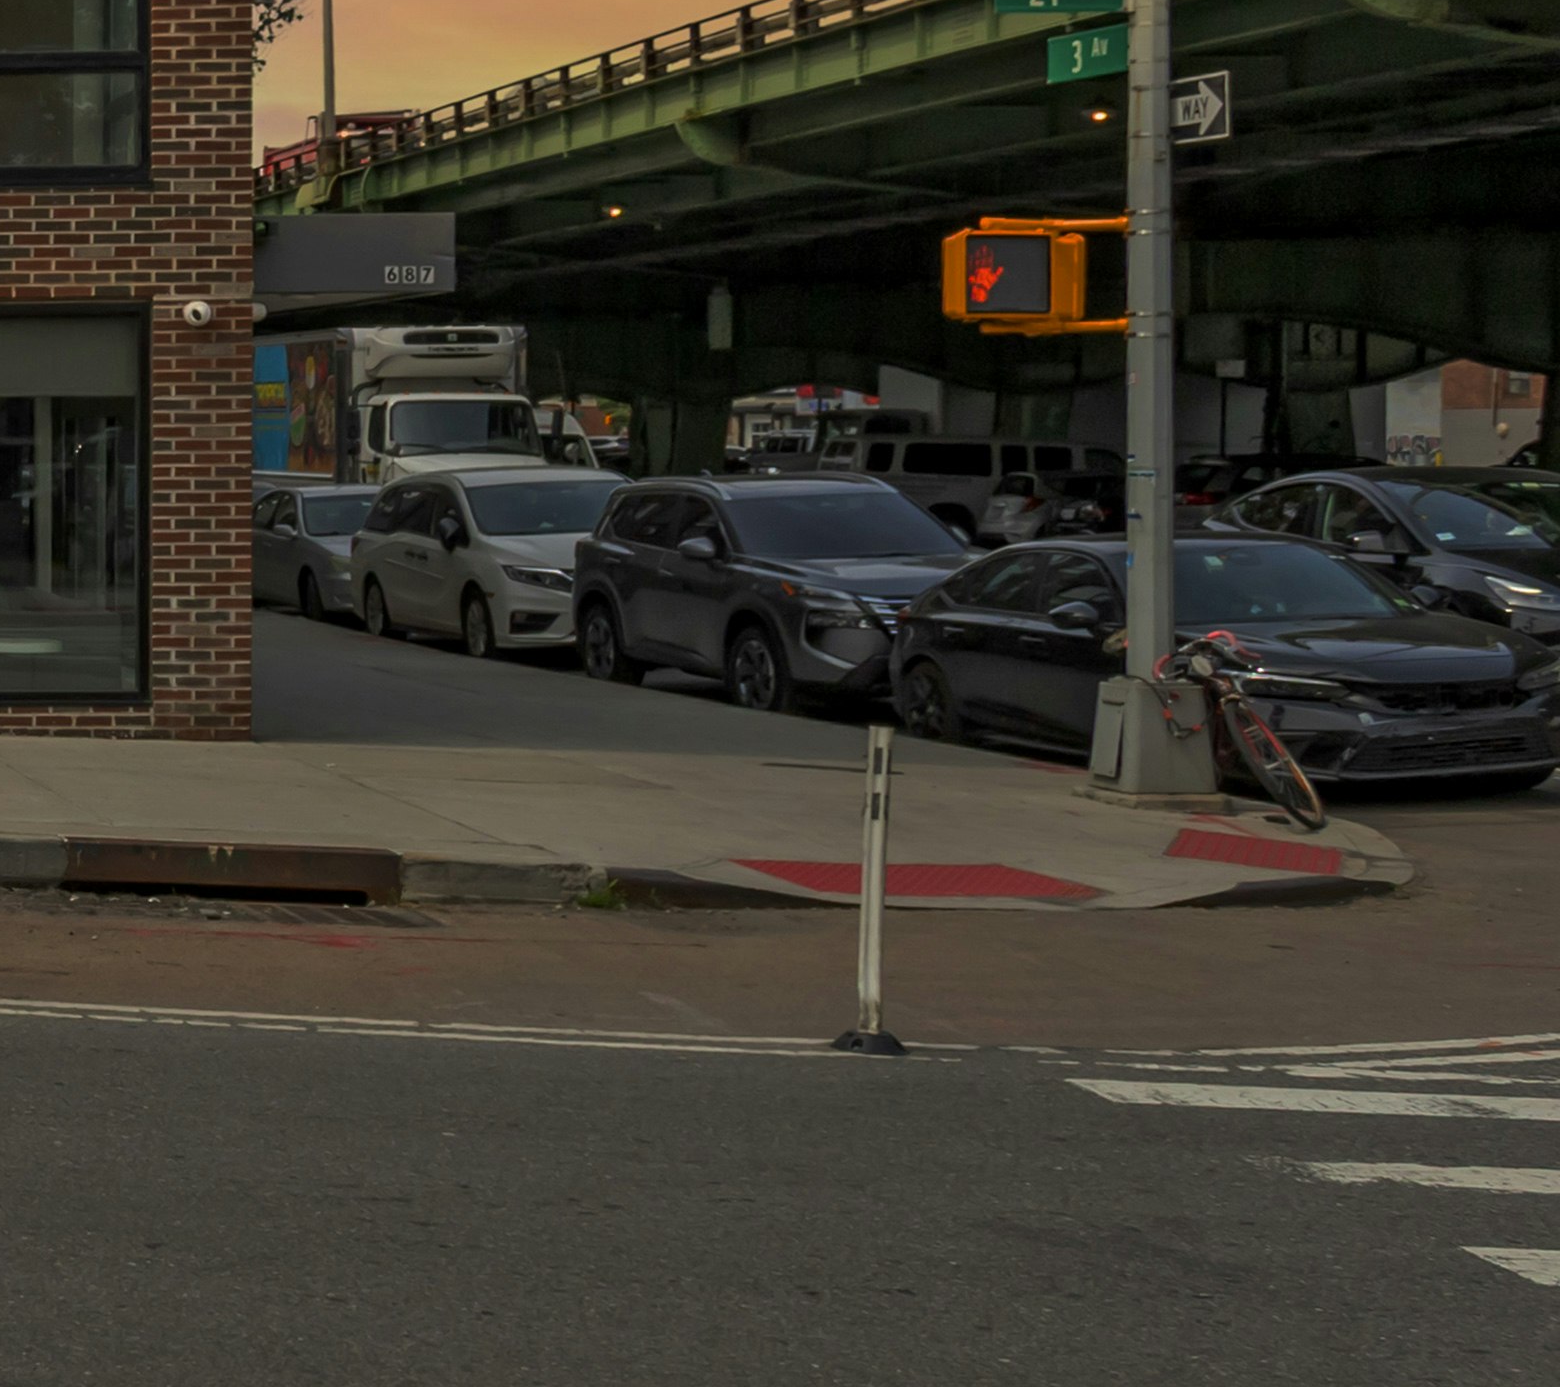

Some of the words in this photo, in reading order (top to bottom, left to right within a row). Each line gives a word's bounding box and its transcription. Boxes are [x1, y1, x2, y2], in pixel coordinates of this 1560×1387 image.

[1071, 39, 1083, 74] 3
[1090, 37, 1109, 57] Av
[1181, 95, 1209, 121] WAY
[387, 267, 432, 282] 687
